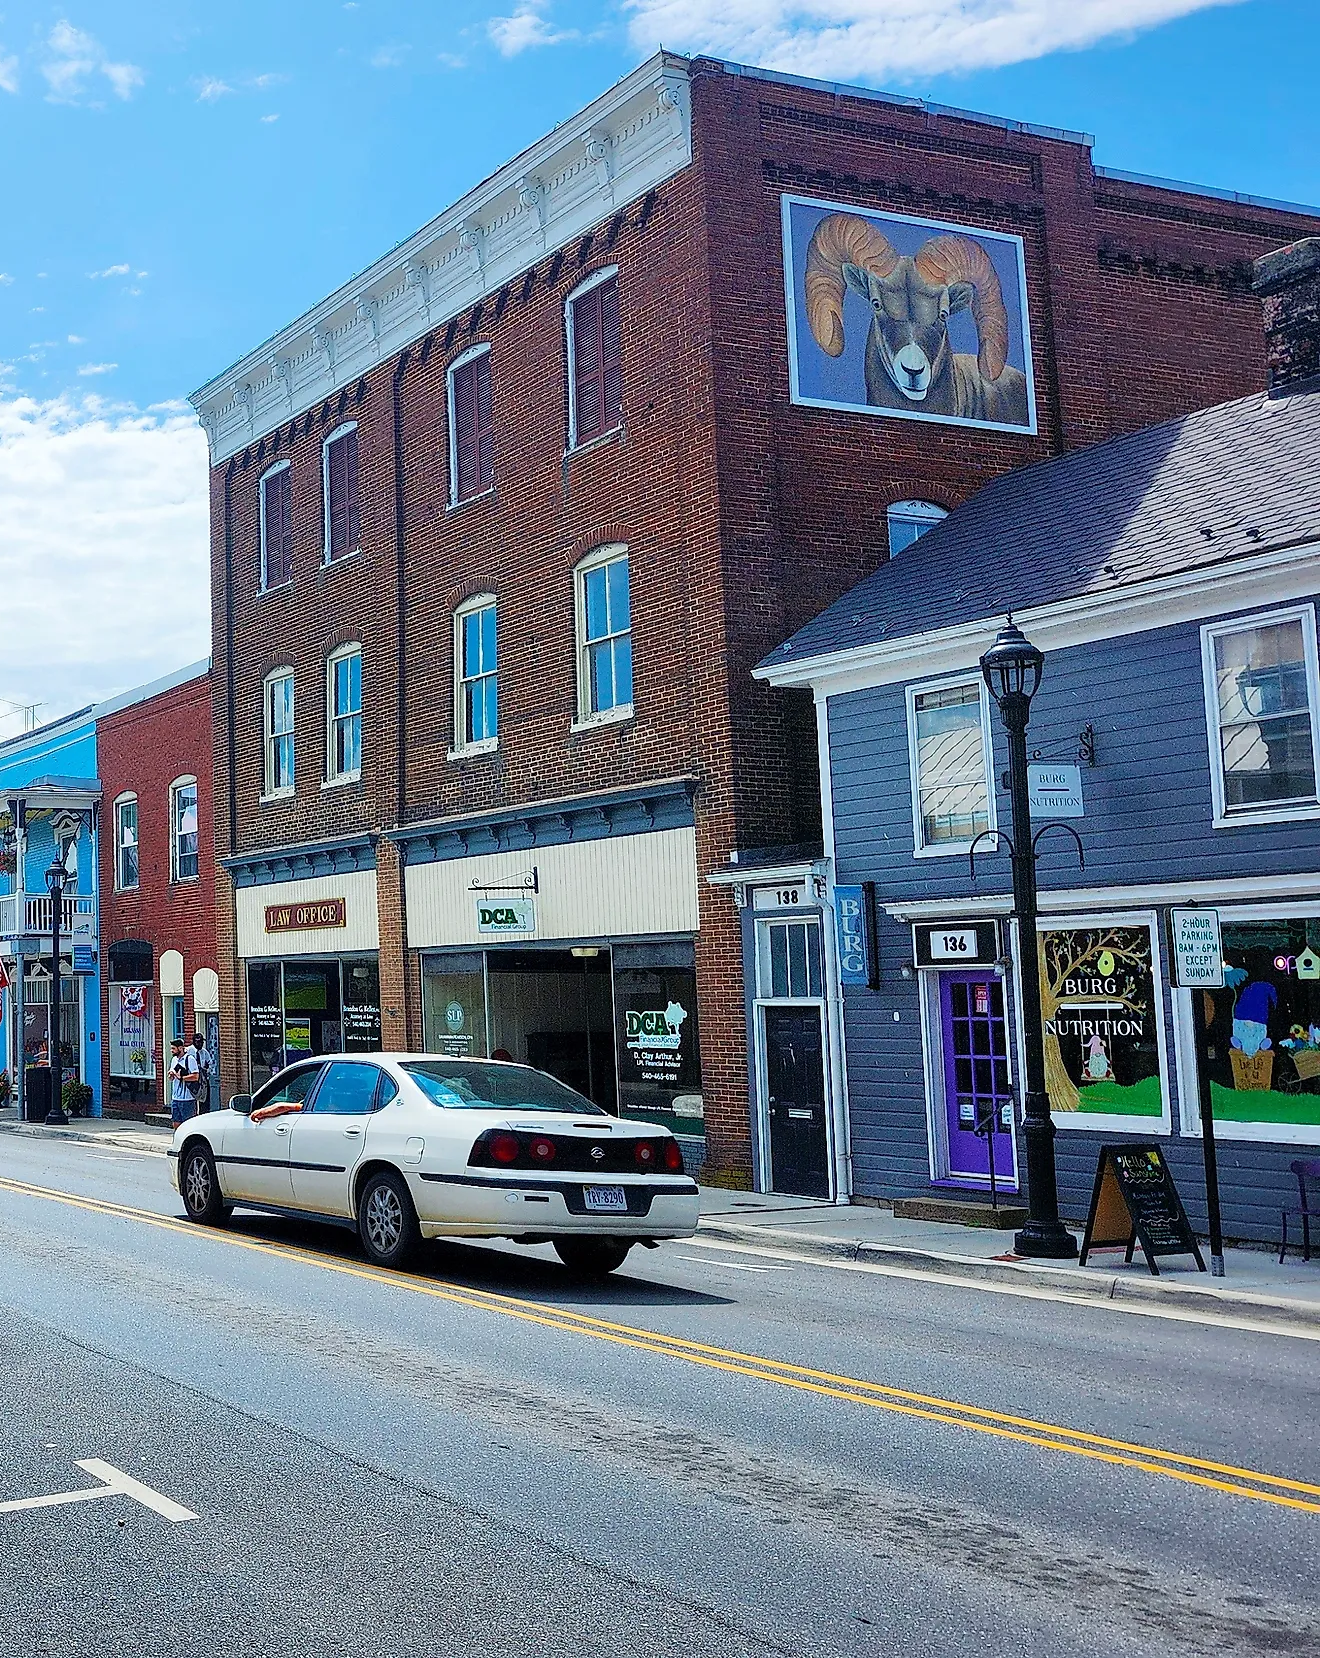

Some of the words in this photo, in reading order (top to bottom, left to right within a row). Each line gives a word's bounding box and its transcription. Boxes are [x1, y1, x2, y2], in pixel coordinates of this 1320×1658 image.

[1039, 774, 1066, 783] BURG
[1030, 797, 1080, 806] NUTRITION
[776, 890, 799, 905] 138
[270, 909, 291, 927] LAW
[296, 904, 337, 924] OFFICE
[479, 908, 518, 925] DCA
[1182, 918, 1211, 929] 2-HOUR
[840, 899, 865, 972] BURG
[1181, 931, 1214, 941] PARKING
[942, 935, 968, 952] 136
[1179, 943, 1194, 953] 8AM
[1202, 943, 1218, 953] 6PM
[1185, 955, 1213, 966] EXCEPT
[1186, 968, 1215, 978] SUNDAY
[1065, 977, 1117, 995] BURG
[627, 1011, 671, 1036] DCA
[1045, 1020, 1144, 1036] NUTRITION
[640, 1035, 663, 1043] Financial
[633, 1051, 640, 1059] D.
[641, 1052, 653, 1061] Clay
[655, 1052, 674, 1060] Arthur,
[1121, 1155, 1146, 1168] Hello
